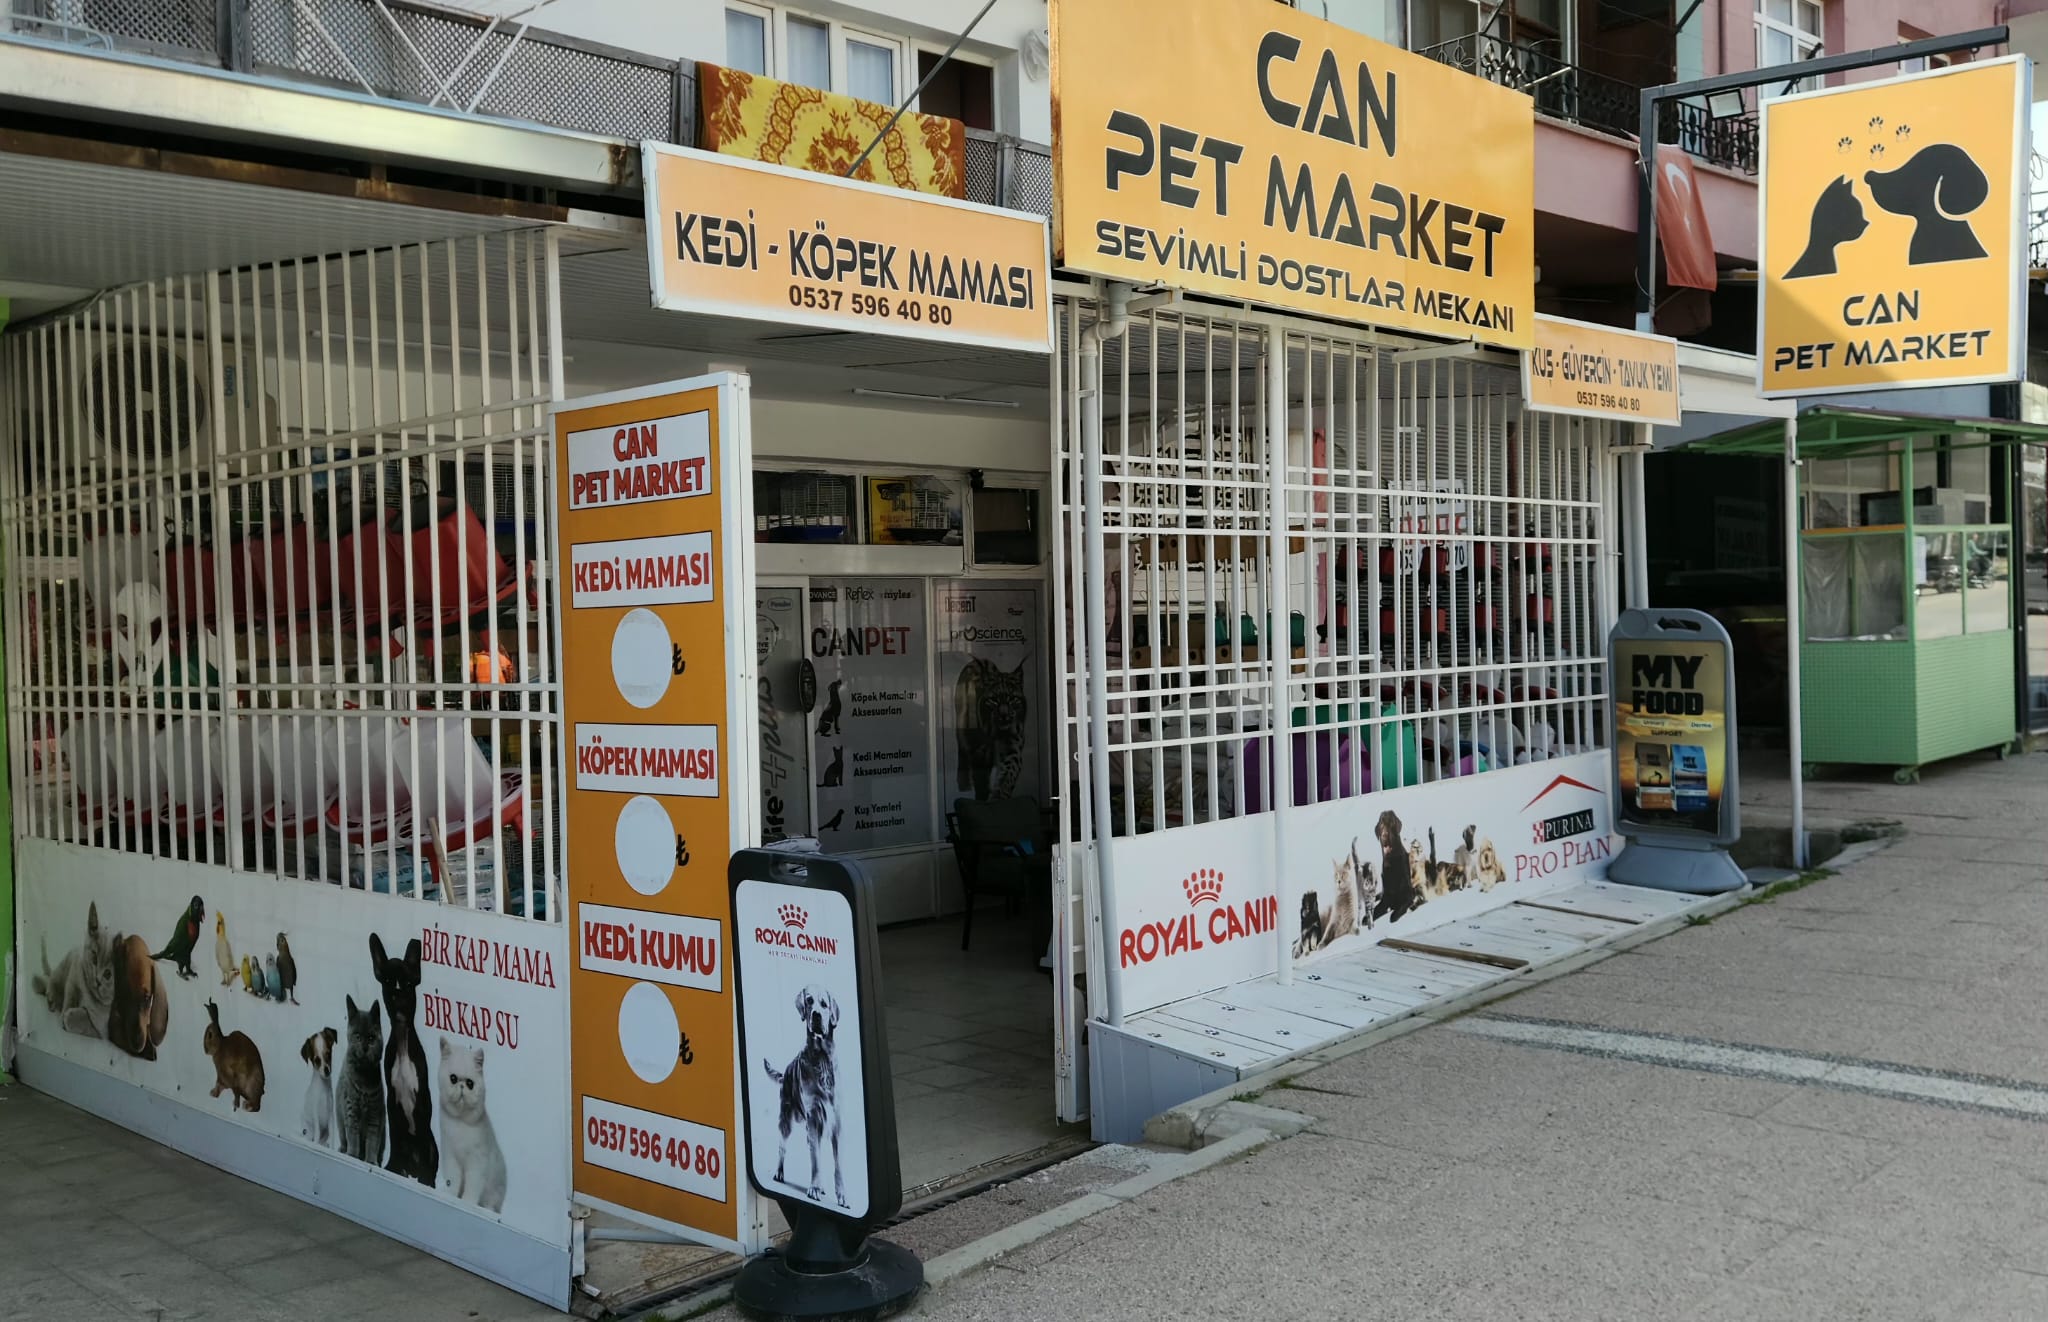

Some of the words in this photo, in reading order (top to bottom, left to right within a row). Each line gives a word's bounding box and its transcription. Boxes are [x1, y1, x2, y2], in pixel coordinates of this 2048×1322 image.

[1256, 31, 1397, 158] CAN
[1105, 109, 1244, 217] PET
[1263, 154, 1506, 278] MARKET
[674, 209, 758, 271] KEDİ
[788, 220, 900, 291] KÖPEK
[908, 248, 1035, 311] MAMASI
[1095, 220, 1246, 281] SEVİMLİ
[1257, 254, 1405, 311] DOSTLAR
[1413, 286, 1514, 333] MEKANI
[788, 284, 843, 313] 0537
[851, 293, 890, 319] 596
[896, 300, 922, 323] 40
[928, 304, 953, 326] 80
[1843, 289, 1919, 327] CAN
[1774, 342, 1835, 372] PET
[1844, 329, 1991, 367] MARKET
[1618, 359, 1649, 390] TAVUK
[1651, 360, 1673, 392] YEMİ
[1577, 391, 1598, 406] 0537
[1600, 393, 1616, 409] 596
[1618, 396, 1628, 410] 40
[1630, 398, 1640, 411] 80
[612, 424, 658, 462] CAN
[573, 470, 610, 505] PET
[613, 456, 706, 501] MARKET
[625, 552, 710, 591] MAMASI
[845, 586, 875, 607] Reflex
[811, 626, 912, 658] CANPET
[1632, 654, 1703, 689] MY
[851, 691, 878, 706] Köpek
[1632, 690, 1704, 716] FOOD
[578, 735, 638, 778] KÖPEK
[640, 746, 715, 781] MAMASI
[853, 751, 872, 763] Kedi
[1545, 812, 1593, 839] PURINA
[1514, 851, 1558, 882] PRO
[1562, 835, 1612, 868] PLAN
[422, 922, 451, 967] BİR
[454, 934, 489, 974] KAP
[492, 942, 556, 989] MAMA
[640, 929, 717, 976] KUMU
[755, 927, 795, 948] ROYAL
[797, 933, 836, 956] CANIN
[1120, 913, 1204, 969] ROYAL
[423, 988, 455, 1034] BİR
[456, 1001, 492, 1042] KAP
[495, 1010, 519, 1050] SU
[587, 1115, 627, 1153] 0537
[629, 1122, 662, 1163] 596
[664, 1134, 691, 1172] 40
[694, 1143, 721, 1179] 80
